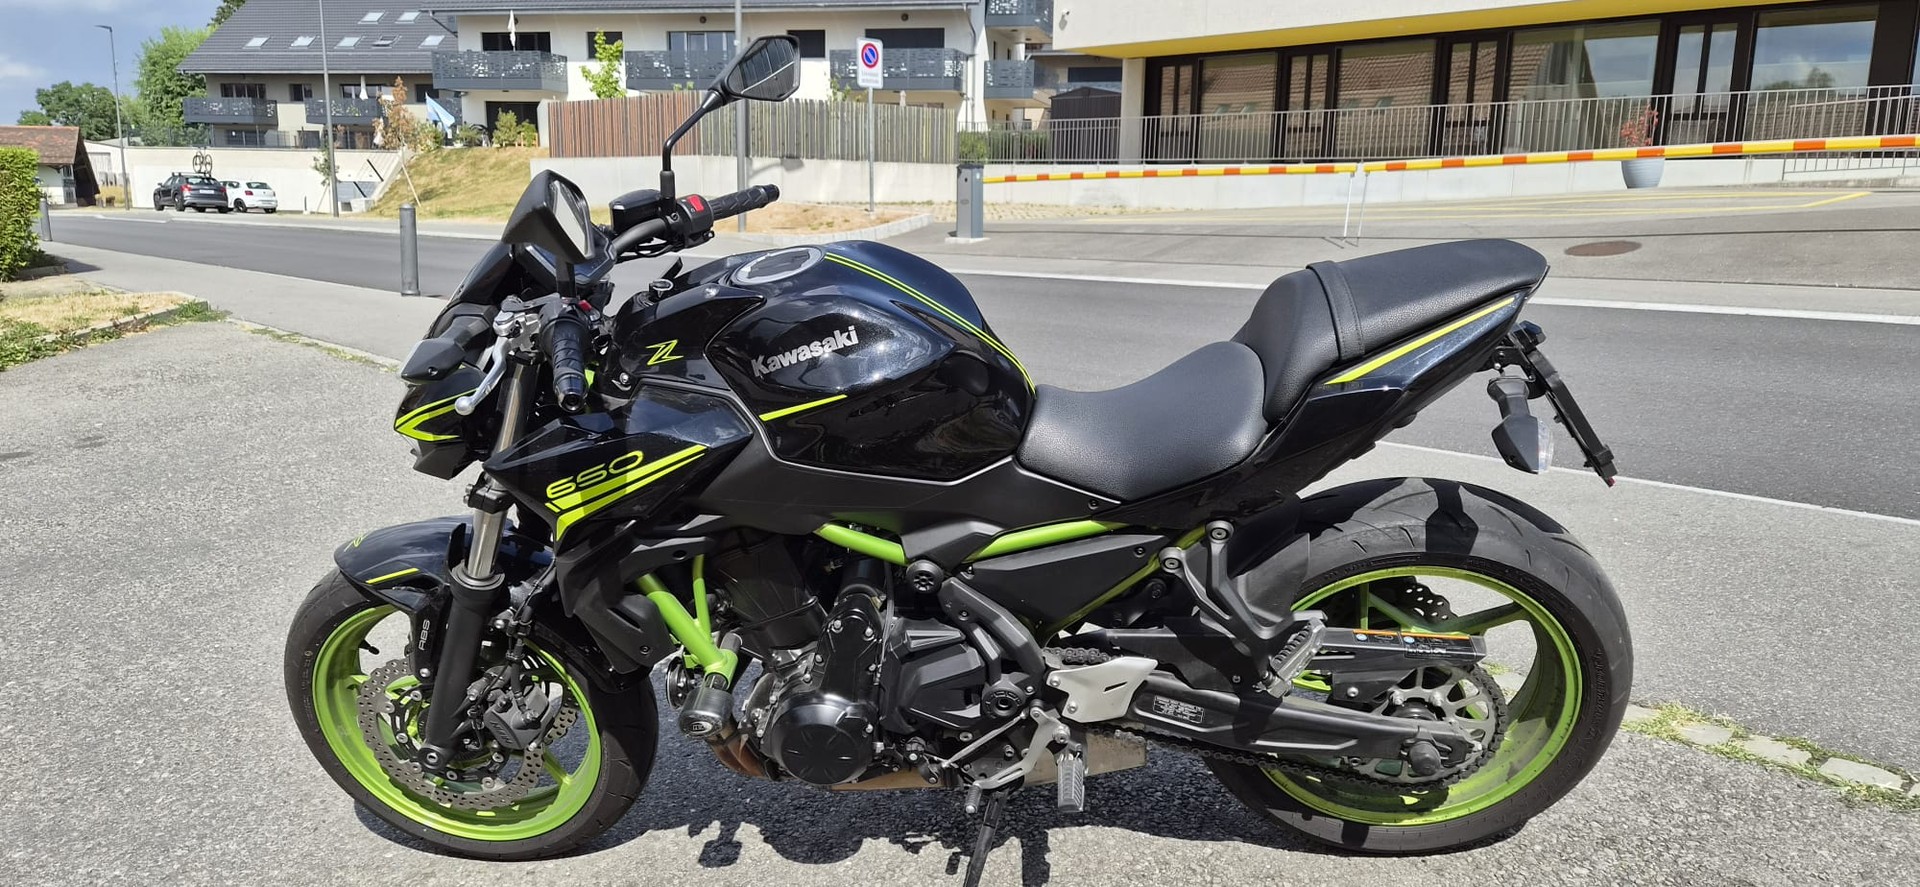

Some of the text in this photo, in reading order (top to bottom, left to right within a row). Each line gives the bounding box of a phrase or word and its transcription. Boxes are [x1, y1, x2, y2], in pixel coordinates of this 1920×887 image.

[646, 339, 684, 366] Z
[751, 325, 859, 377] Kawasaki
[546, 450, 644, 499] 650
[418, 619, 431, 651] ABS
